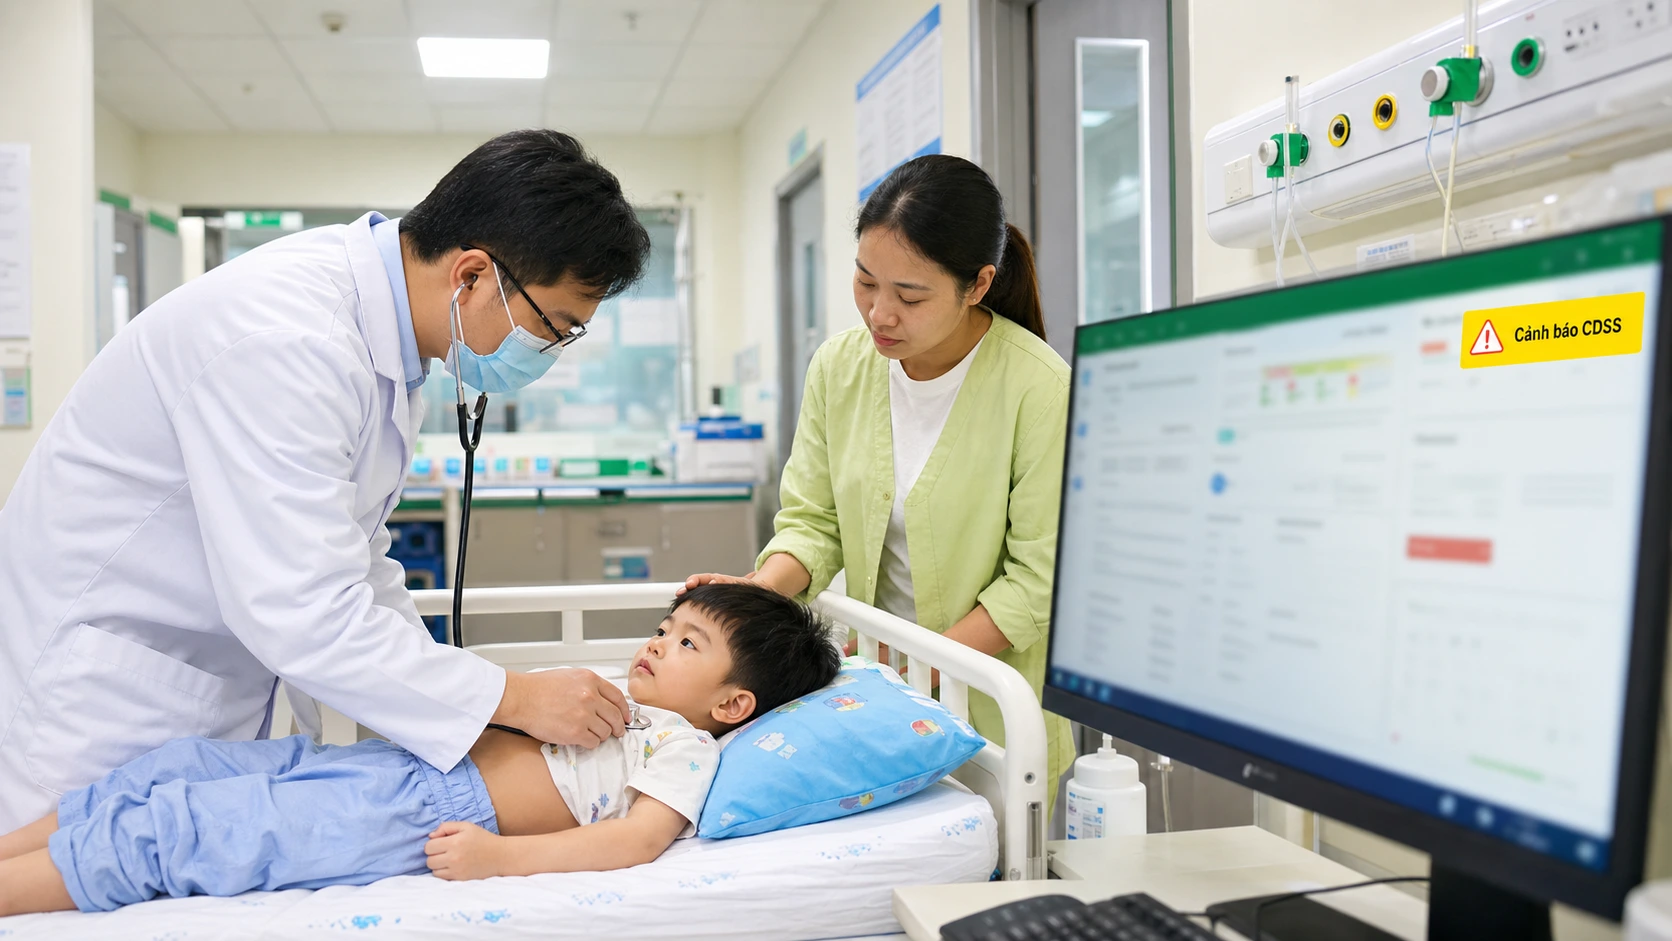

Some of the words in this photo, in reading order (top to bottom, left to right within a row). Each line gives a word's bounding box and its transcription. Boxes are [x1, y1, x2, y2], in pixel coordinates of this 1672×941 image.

[1514, 325, 1549, 342] Cảnh
[1553, 322, 1578, 338] báo
[1582, 317, 1622, 335] CDSS
